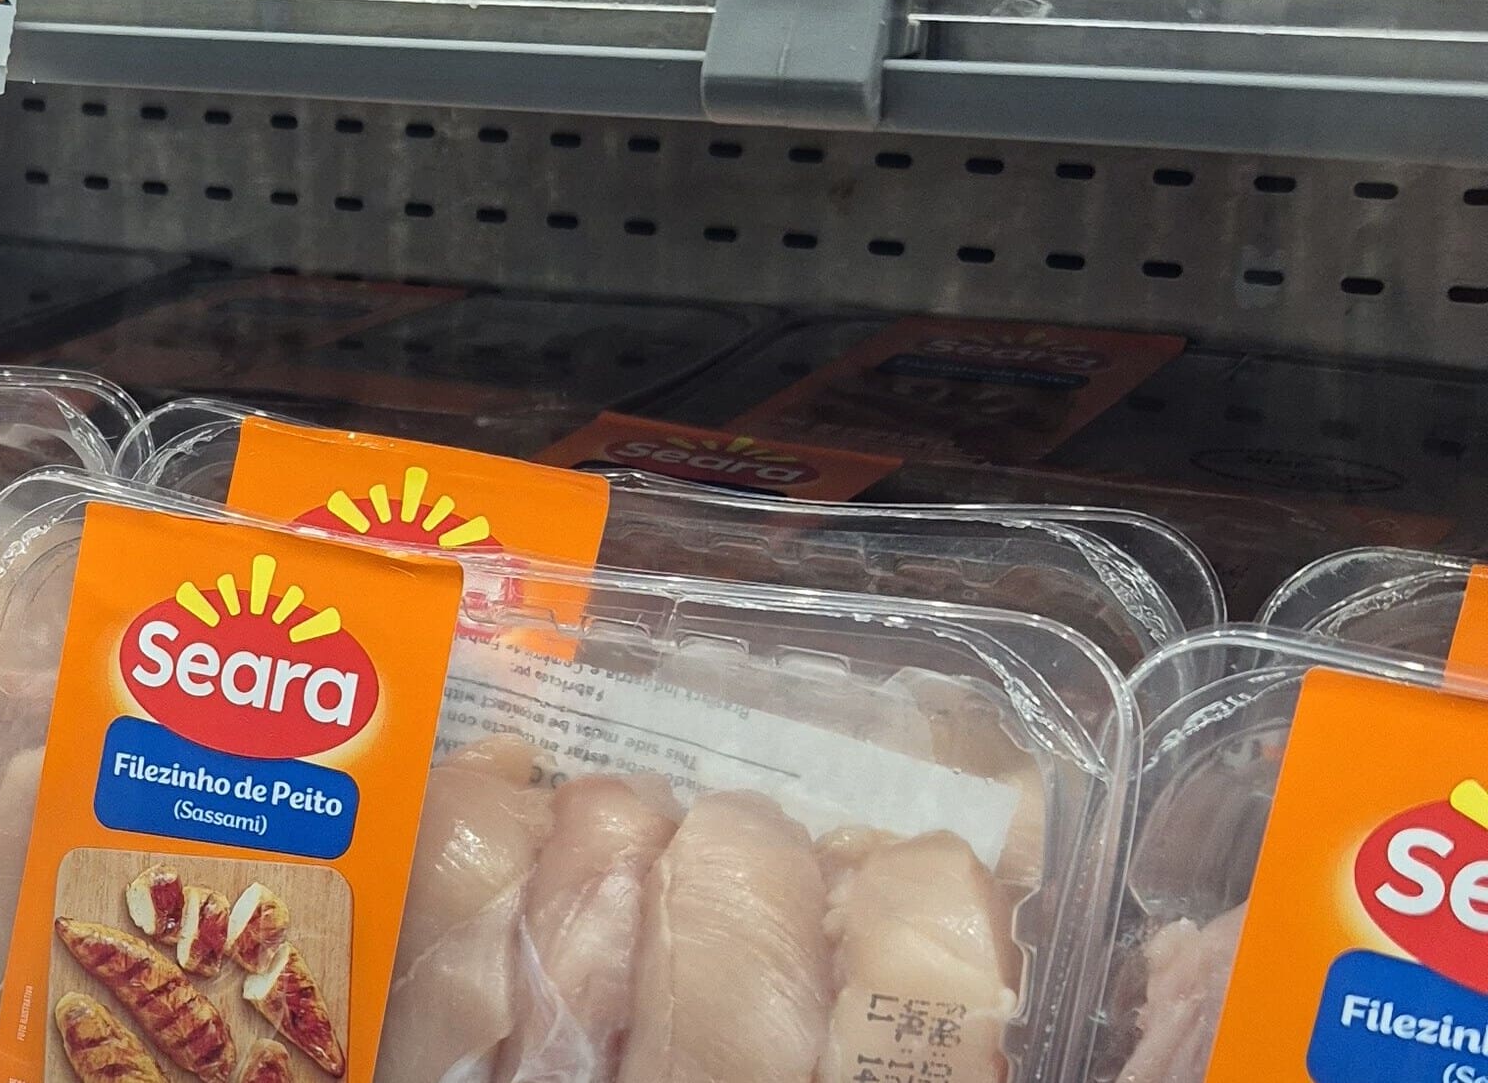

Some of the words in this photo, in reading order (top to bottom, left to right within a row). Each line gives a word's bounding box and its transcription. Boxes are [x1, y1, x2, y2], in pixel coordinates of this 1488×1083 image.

[131, 620, 360, 727] Seara
[624, 736, 660, 756] side
[113, 754, 231, 796] Filezinho
[234, 775, 268, 803] de
[271, 776, 344, 818] Peito
[173, 800, 269, 837] (Sassami)
[1340, 994, 1488, 1058] Filezin
